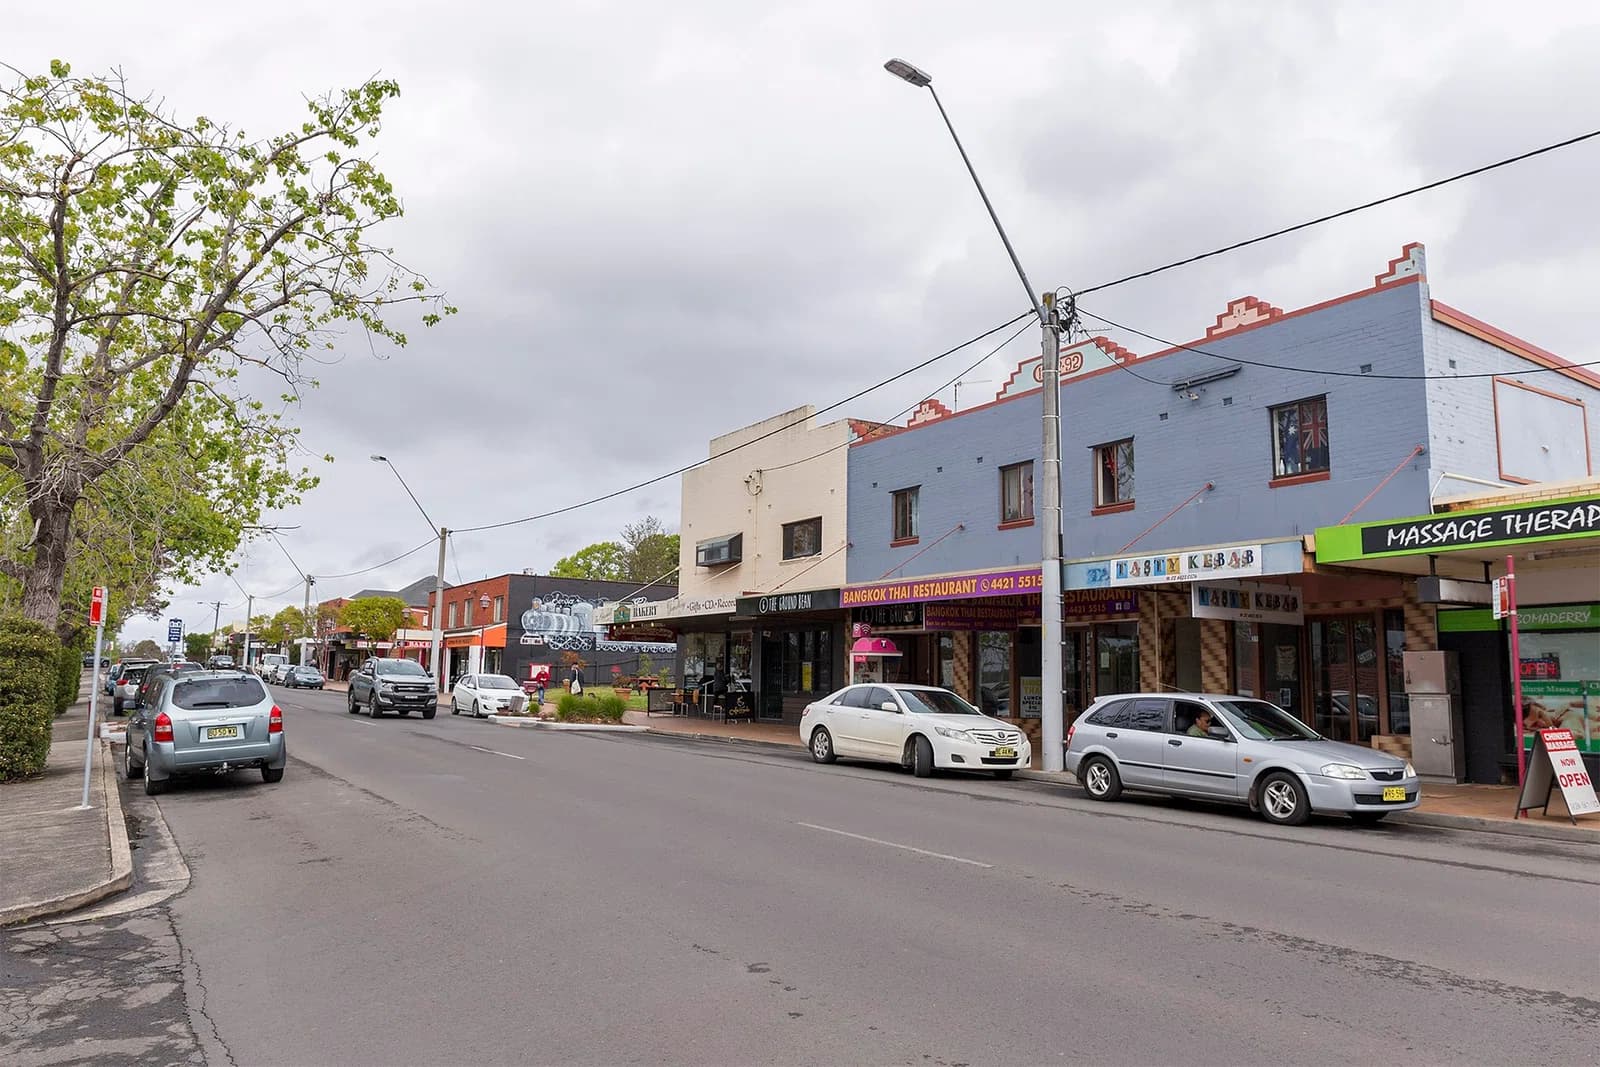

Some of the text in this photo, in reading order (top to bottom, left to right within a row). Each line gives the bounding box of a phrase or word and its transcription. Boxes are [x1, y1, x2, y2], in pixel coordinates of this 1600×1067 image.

[1387, 504, 1600, 547] MASSAGE THERAP
[1116, 550, 1254, 578] TASTY KEBAB
[843, 573, 1042, 604] BANGKOK THAI RESTAURANT 4421 5515
[769, 593, 812, 611] THE GROUND BEAN
[1199, 586, 1298, 611] TASTY KEBAB
[633, 606, 657, 618] BAKERY
[926, 606, 959, 618] BANGKOK
[961, 606, 976, 618] THAI
[977, 606, 1016, 619] RESTAURANT
[1521, 684, 1545, 694] hinese
[1560, 758, 1576, 768] NOW
[1559, 772, 1591, 788] OPEN
